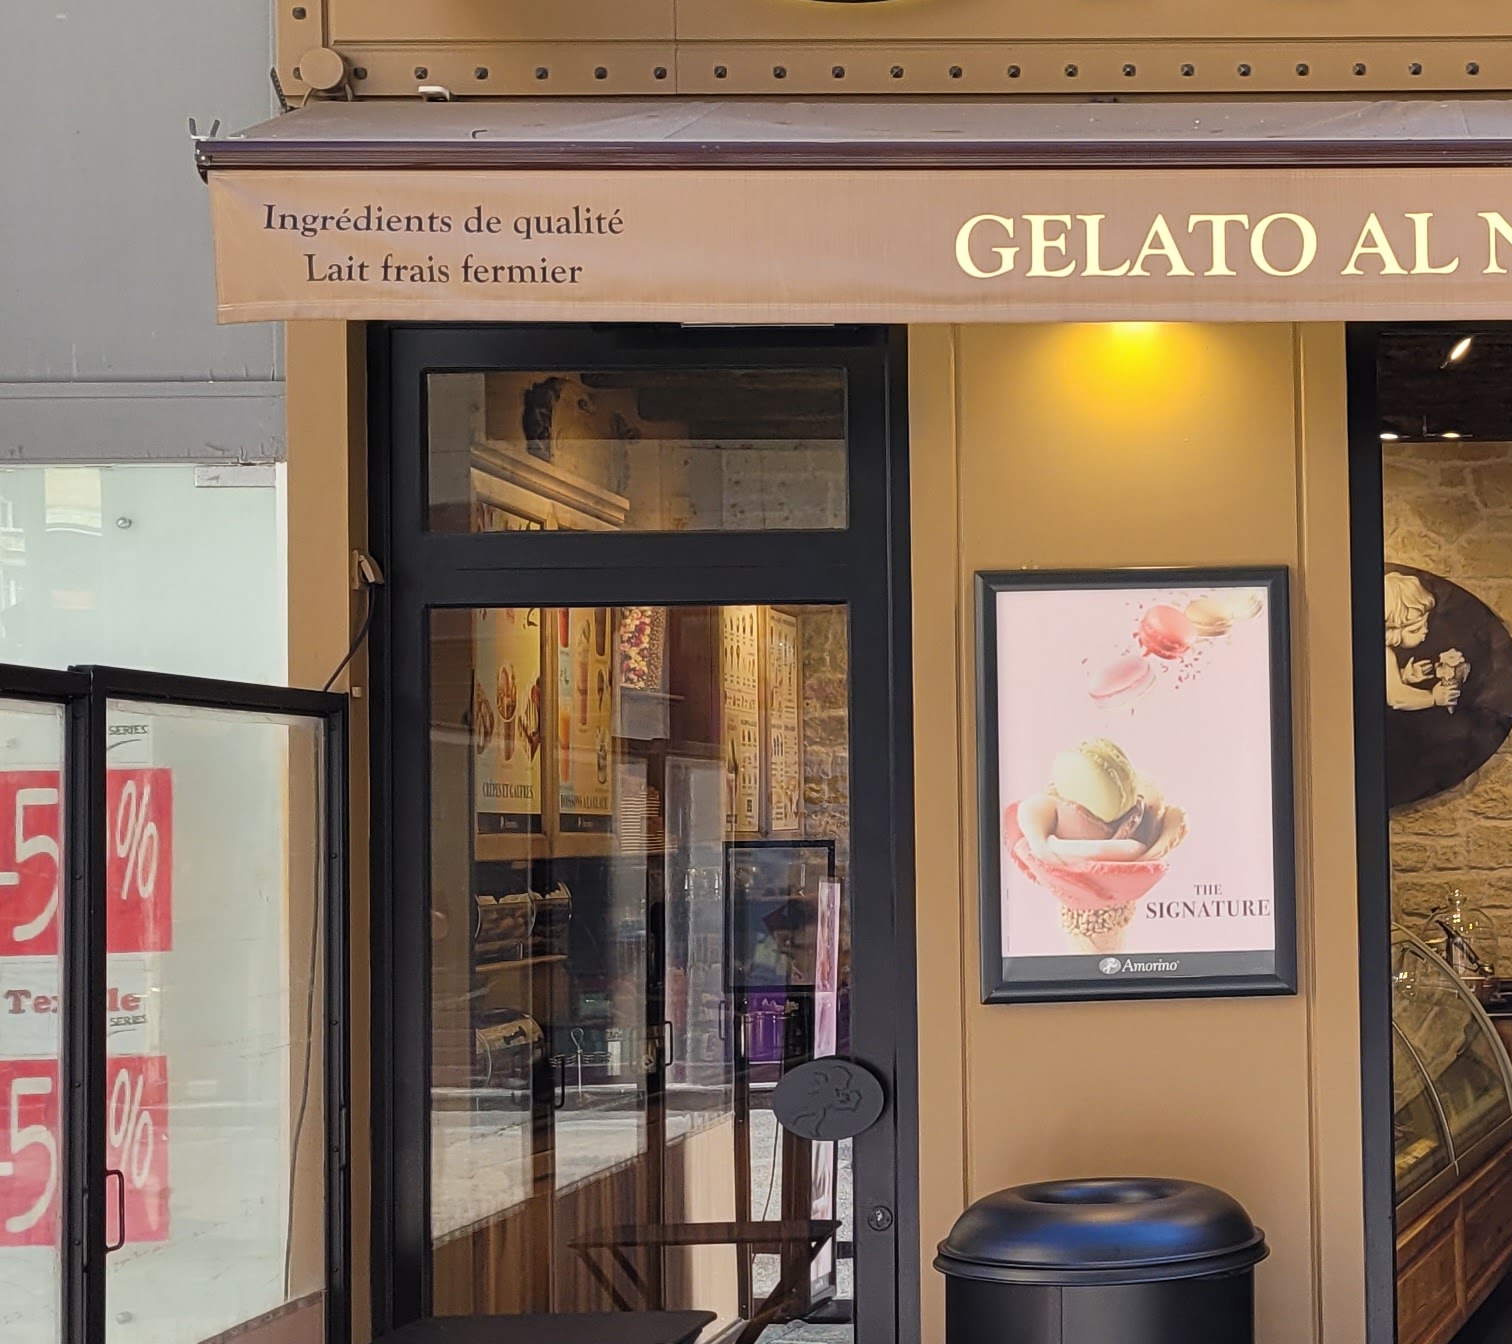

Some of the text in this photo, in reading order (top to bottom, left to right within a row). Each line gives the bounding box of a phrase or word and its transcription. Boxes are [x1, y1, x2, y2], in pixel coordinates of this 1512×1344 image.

[263, 203, 624, 240] Ingrédients de qualité
[955, 211, 1319, 278] GELATO
[1340, 212, 1459, 275] AL
[303, 253, 583, 284] Lait frais fermier
[1193, 884, 1223, 896] THE
[1146, 899, 1271, 920] SIGNATURE
[1121, 958, 1179, 973] Amorino
